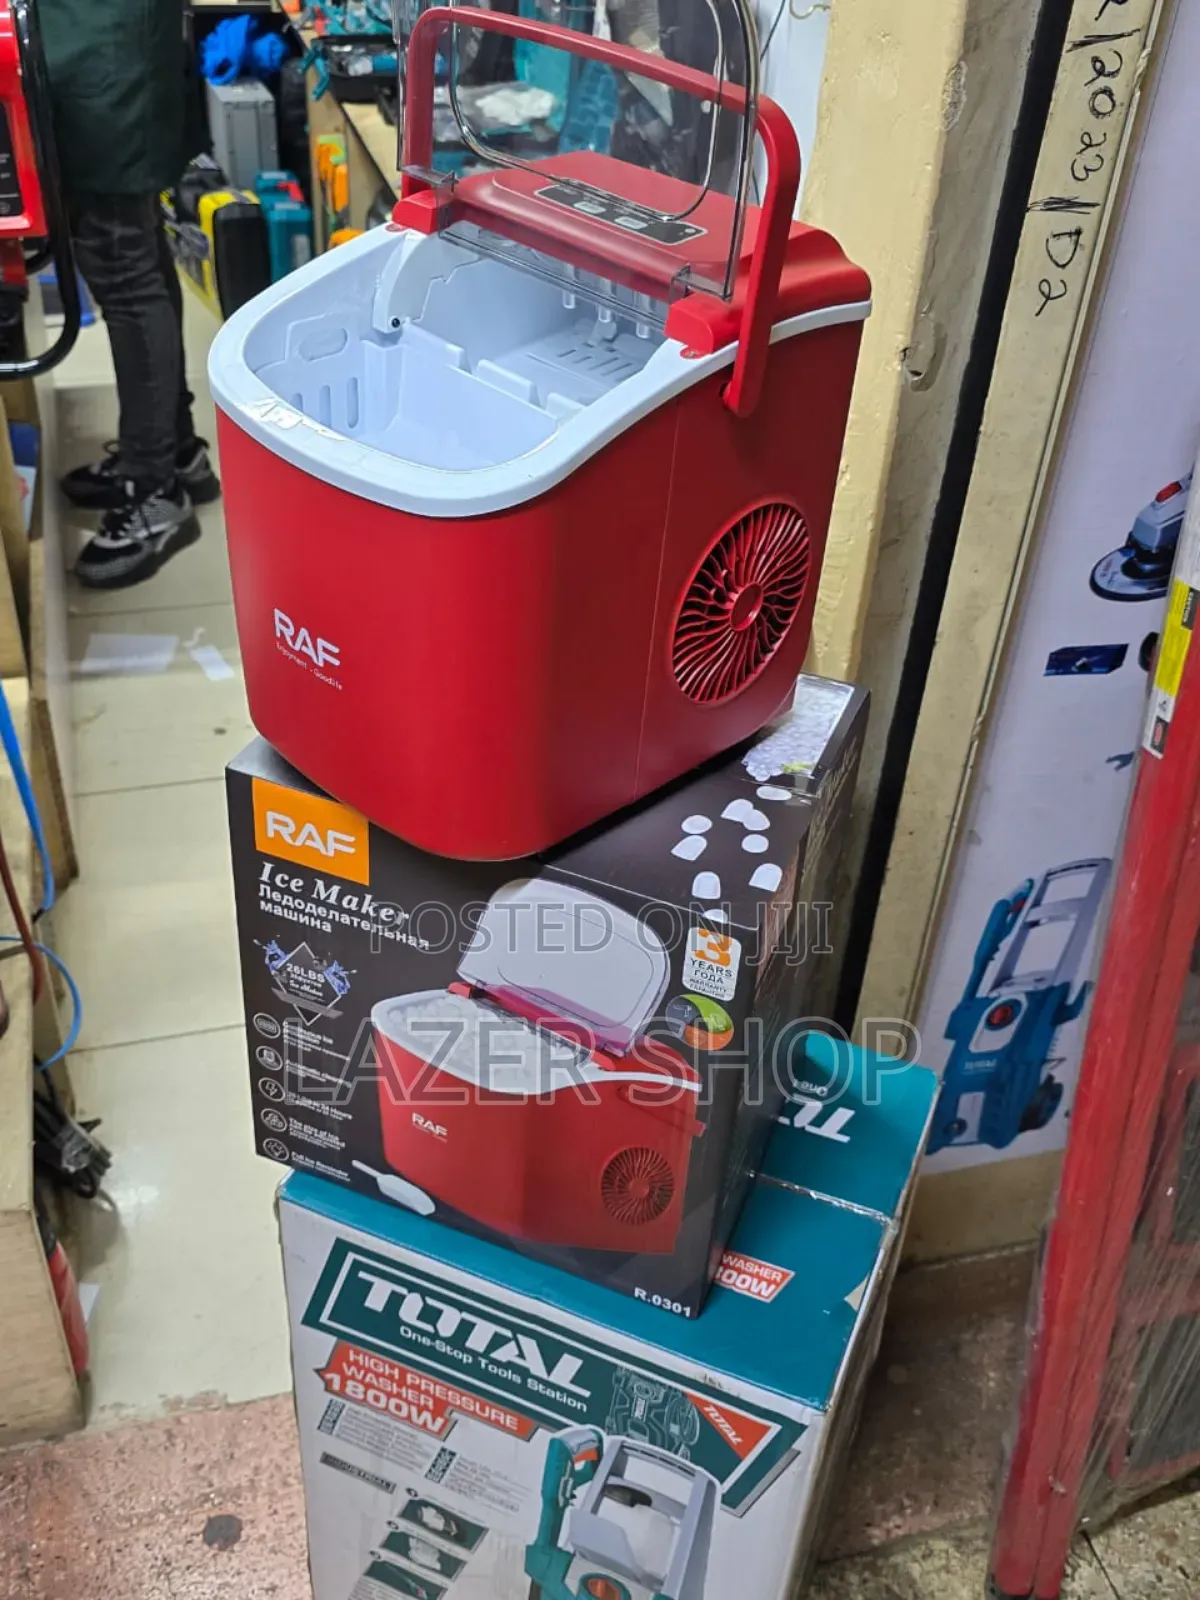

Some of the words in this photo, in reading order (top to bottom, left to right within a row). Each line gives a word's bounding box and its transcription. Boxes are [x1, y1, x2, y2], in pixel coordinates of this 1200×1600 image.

[273, 607, 341, 668] RAF
[265, 810, 356, 857] RAF
[258, 861, 305, 893] Ice
[311, 877, 409, 926] Maker
[258, 883, 430, 950] Ледоделательная
[259, 900, 332, 933] машина
[690, 957, 733, 978] YEARS
[694, 928, 732, 968] 3
[694, 969, 724, 985] ГОДА
[411, 1111, 448, 1137] RAF
[721, 1253, 783, 1283] WASHER
[633, 1286, 692, 1318] R.0301
[357, 1270, 592, 1398] TOTAL
[341, 1361, 435, 1411] WASHER
[348, 1349, 400, 1380] HIGH
[405, 1371, 519, 1432] PRESSURE
[399, 1325, 474, 1366] One-Stop
[477, 1356, 523, 1385] Tools
[526, 1377, 589, 1414] Station
[324, 1371, 446, 1433] 1800W
